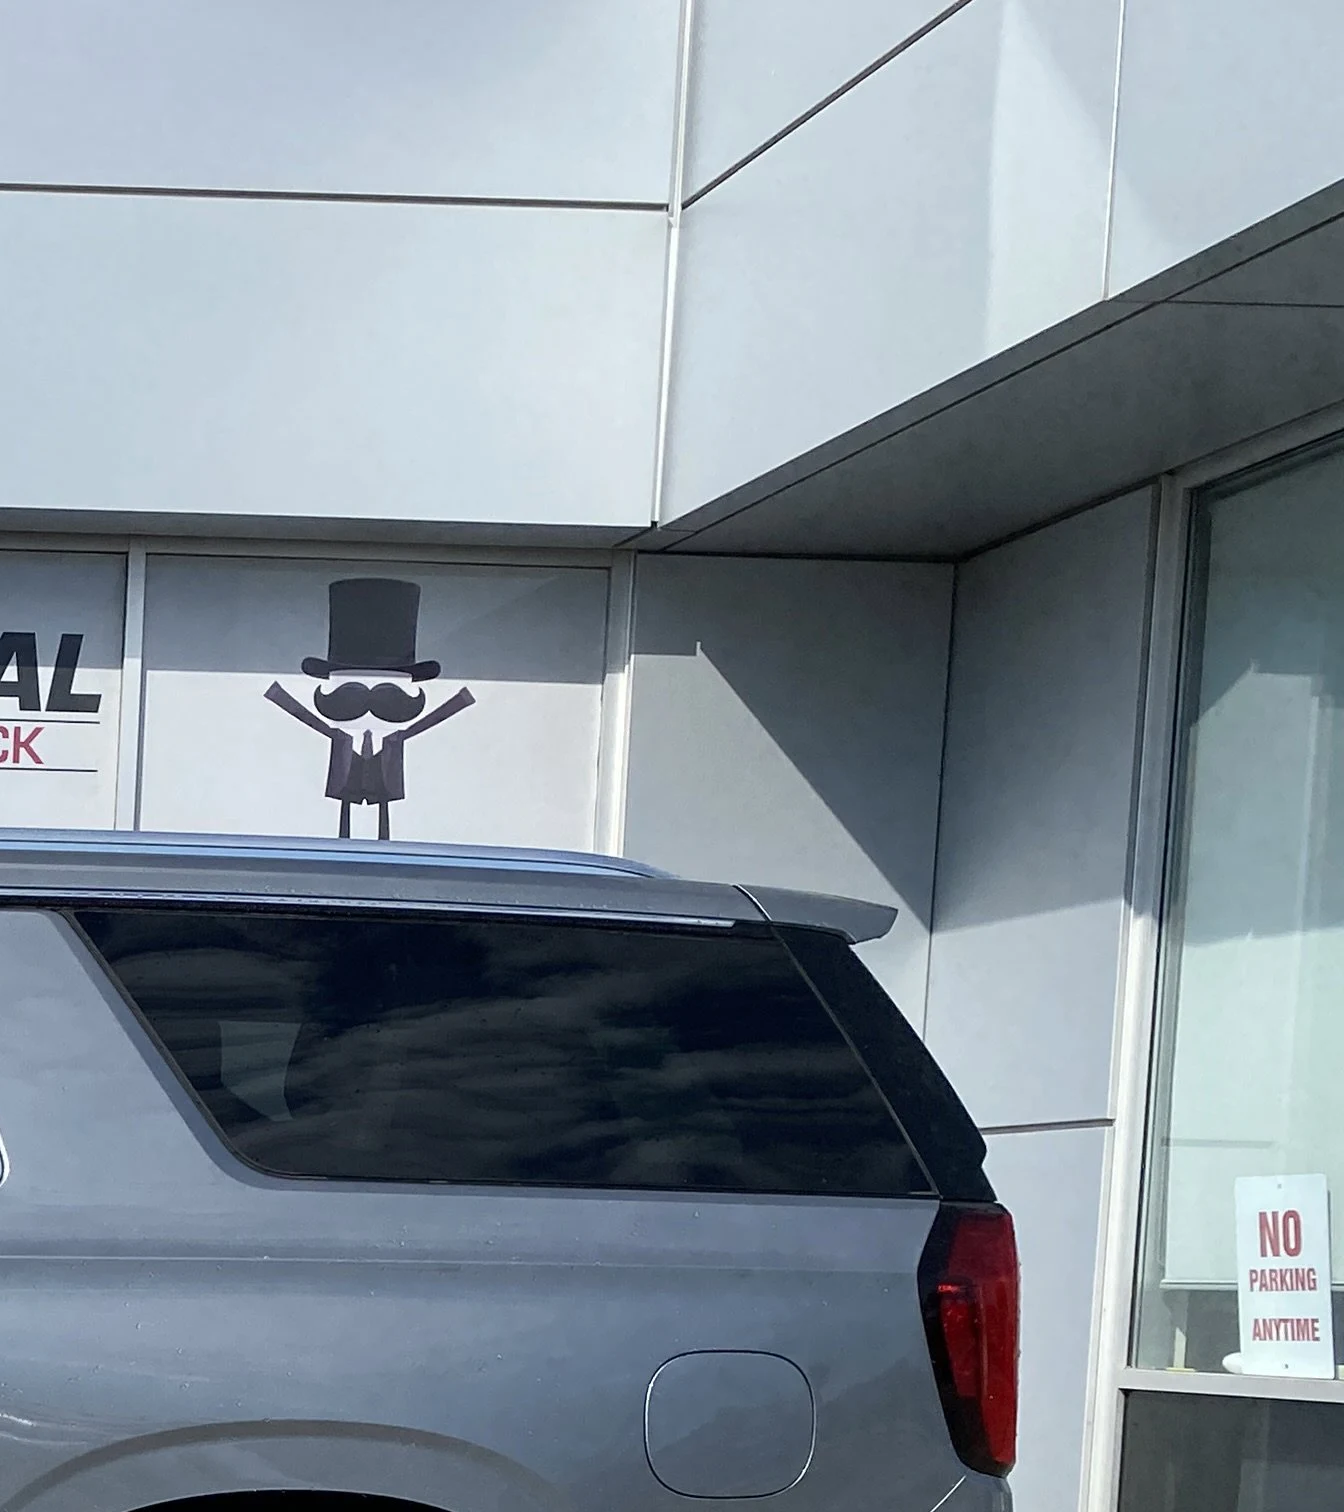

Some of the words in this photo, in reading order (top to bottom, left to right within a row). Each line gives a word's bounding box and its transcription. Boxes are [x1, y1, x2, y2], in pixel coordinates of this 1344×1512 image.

[1258, 1209, 1302, 1258] NO
[1248, 1267, 1318, 1292] PARKING
[1252, 1318, 1321, 1342] ANYTIME
